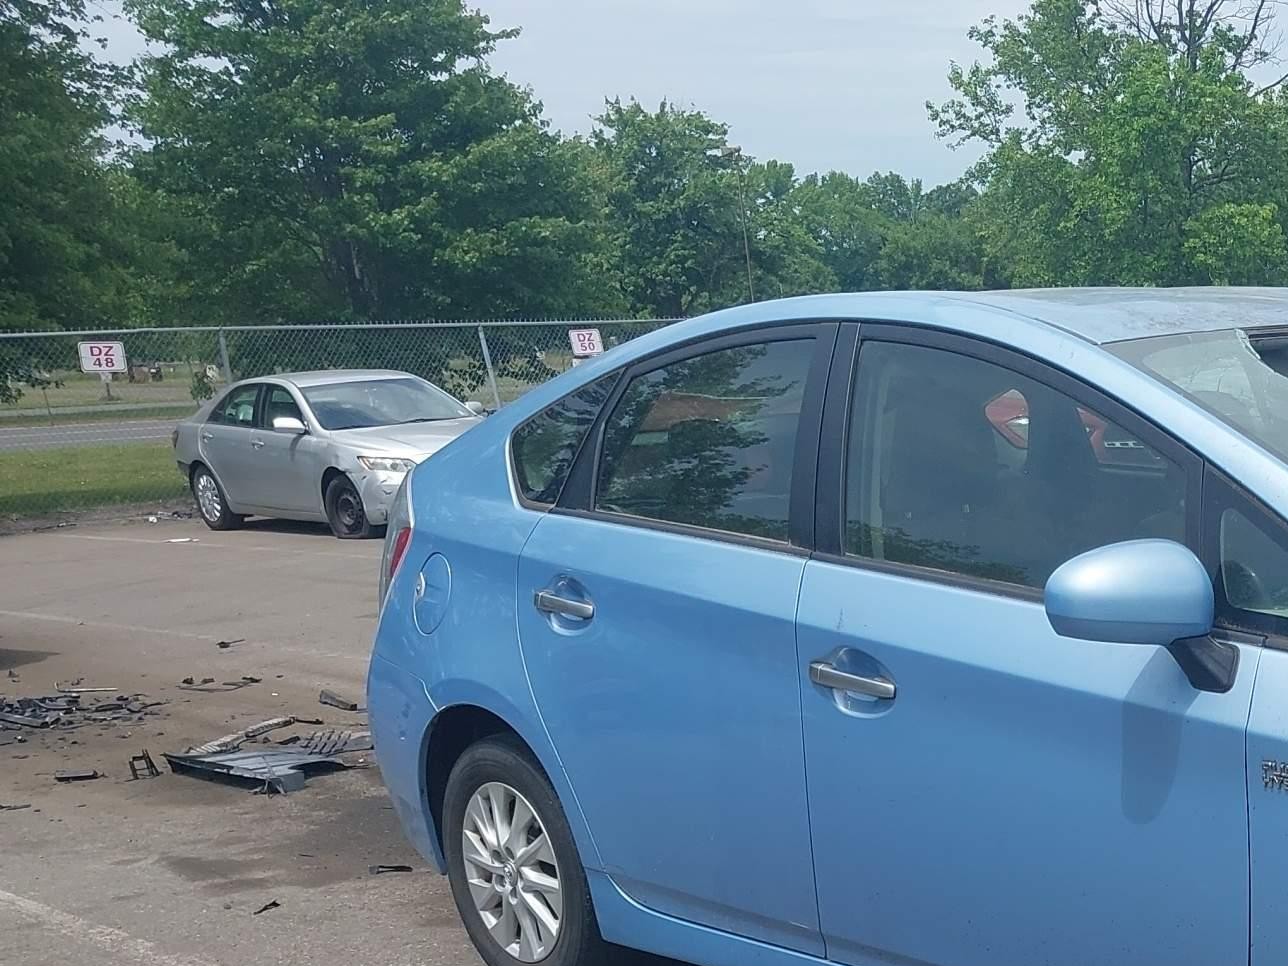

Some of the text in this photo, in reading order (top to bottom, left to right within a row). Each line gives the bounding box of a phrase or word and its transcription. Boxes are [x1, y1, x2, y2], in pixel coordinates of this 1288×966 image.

[577, 332, 594, 342] DZ
[90, 346, 115, 357] DZ
[580, 342, 595, 352] 50
[93, 357, 116, 368] 48
